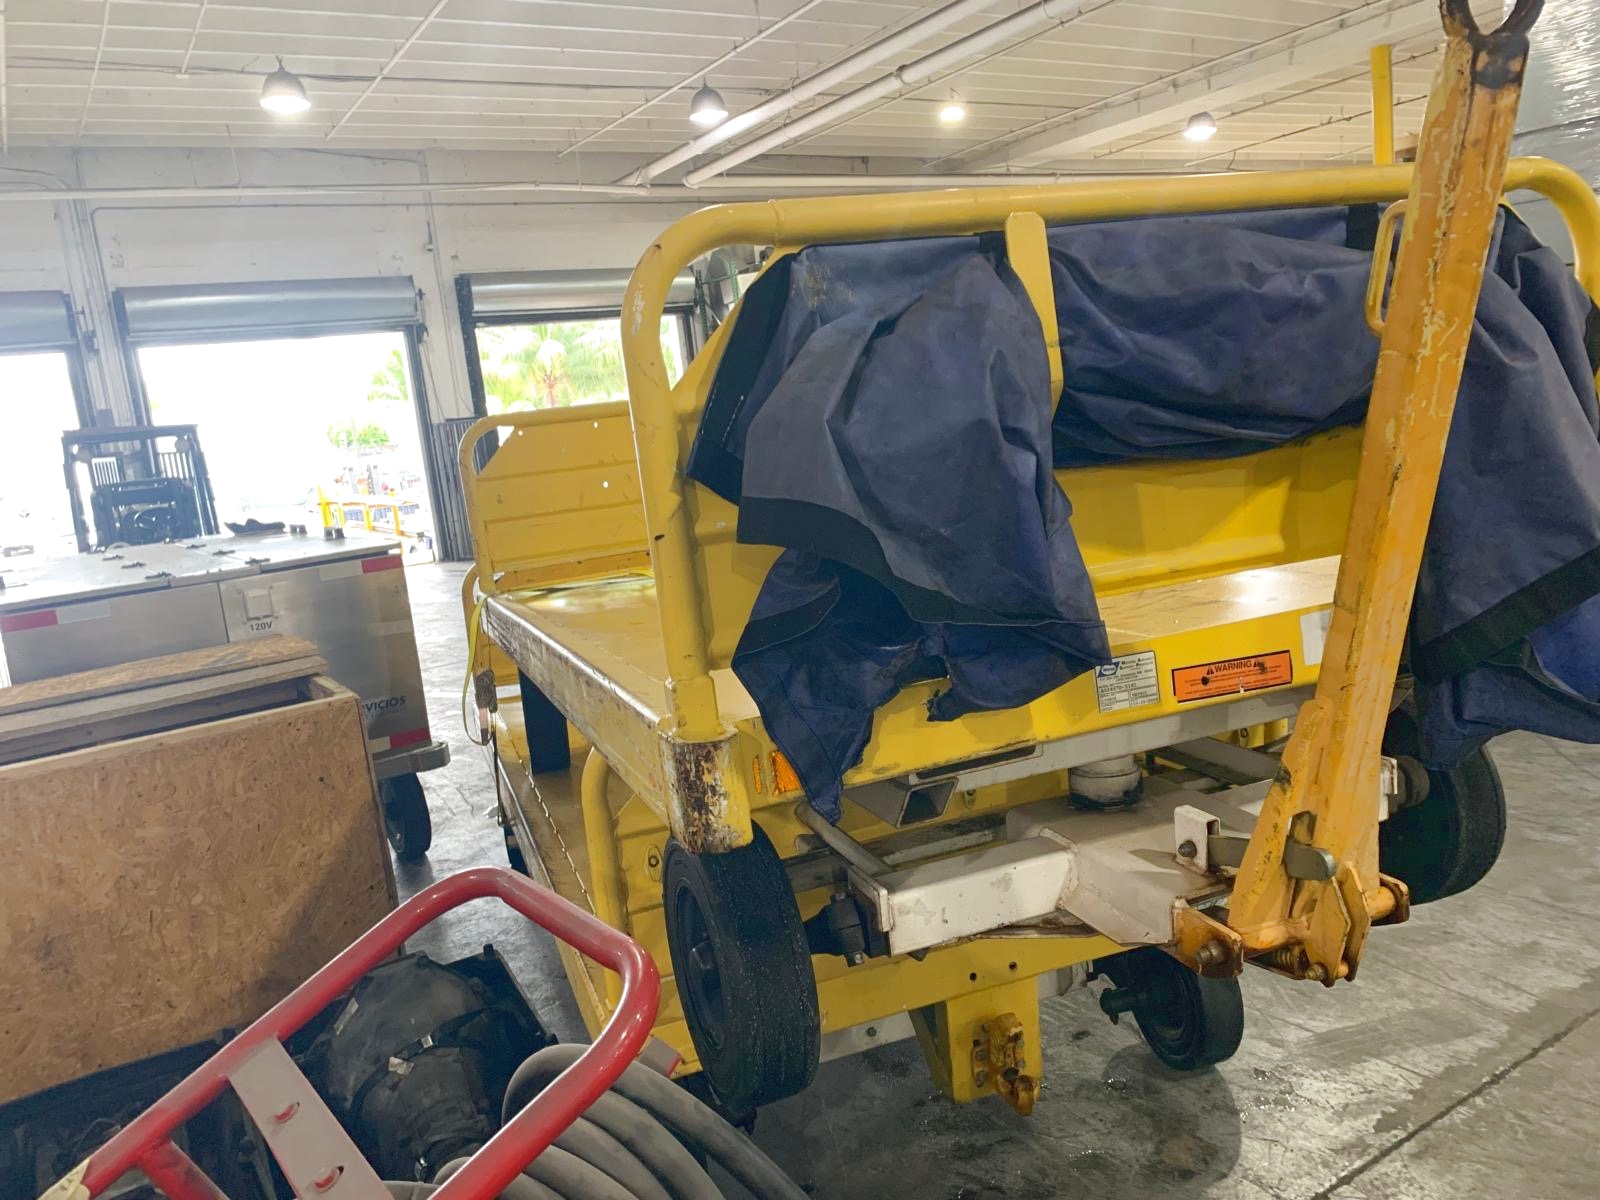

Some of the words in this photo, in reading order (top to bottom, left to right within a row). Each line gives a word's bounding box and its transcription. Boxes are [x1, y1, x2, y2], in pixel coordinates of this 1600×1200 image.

[250, 621, 272, 631] 120V
[1214, 660, 1252, 673] WARNING
[362, 696, 406, 712] VICIOS
